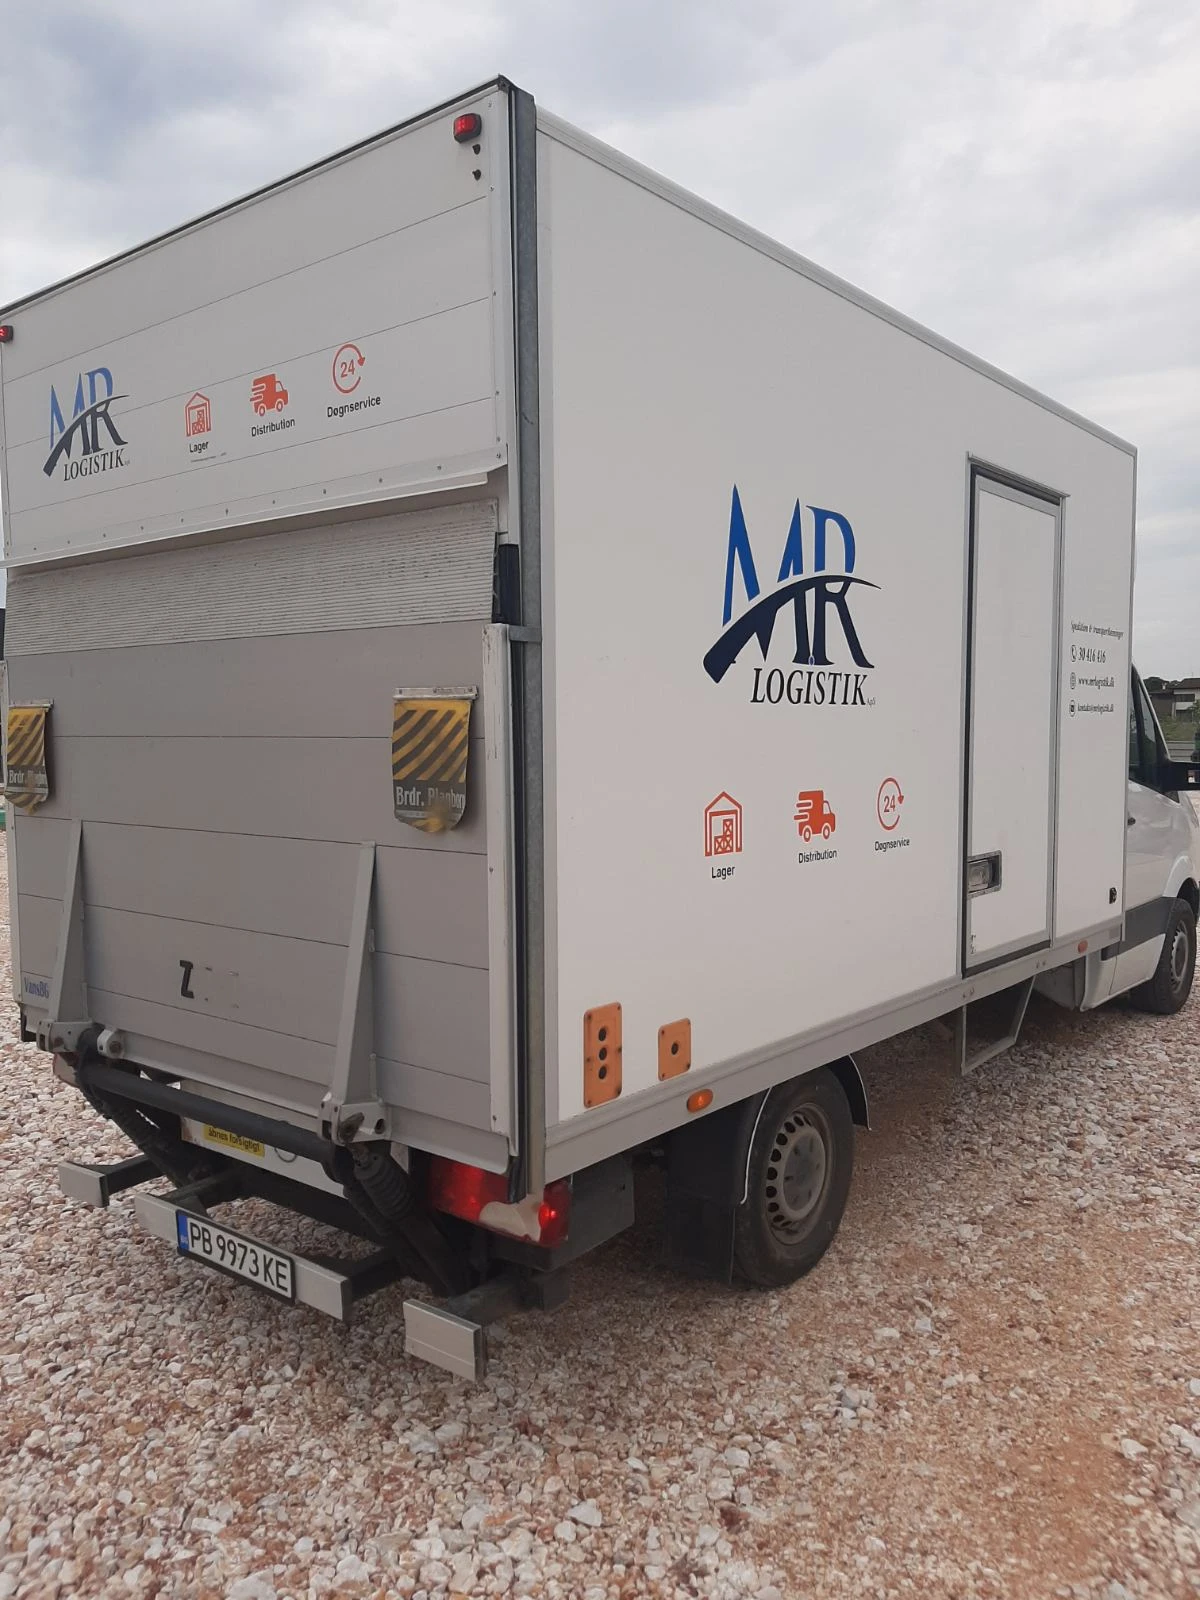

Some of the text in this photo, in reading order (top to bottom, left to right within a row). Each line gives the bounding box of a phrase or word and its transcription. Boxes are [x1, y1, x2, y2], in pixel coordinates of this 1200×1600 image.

[340, 359, 355, 378] 24
[251, 417, 296, 437] Distribution
[189, 441, 209, 454] Lager
[63, 449, 125, 482] LOGISTIK
[750, 667, 868, 705] LOGISTIK
[396, 786, 425, 806] Brdr.
[884, 795, 895, 812] 24
[798, 848, 838, 863] Distribution
[711, 865, 735, 879] Lager
